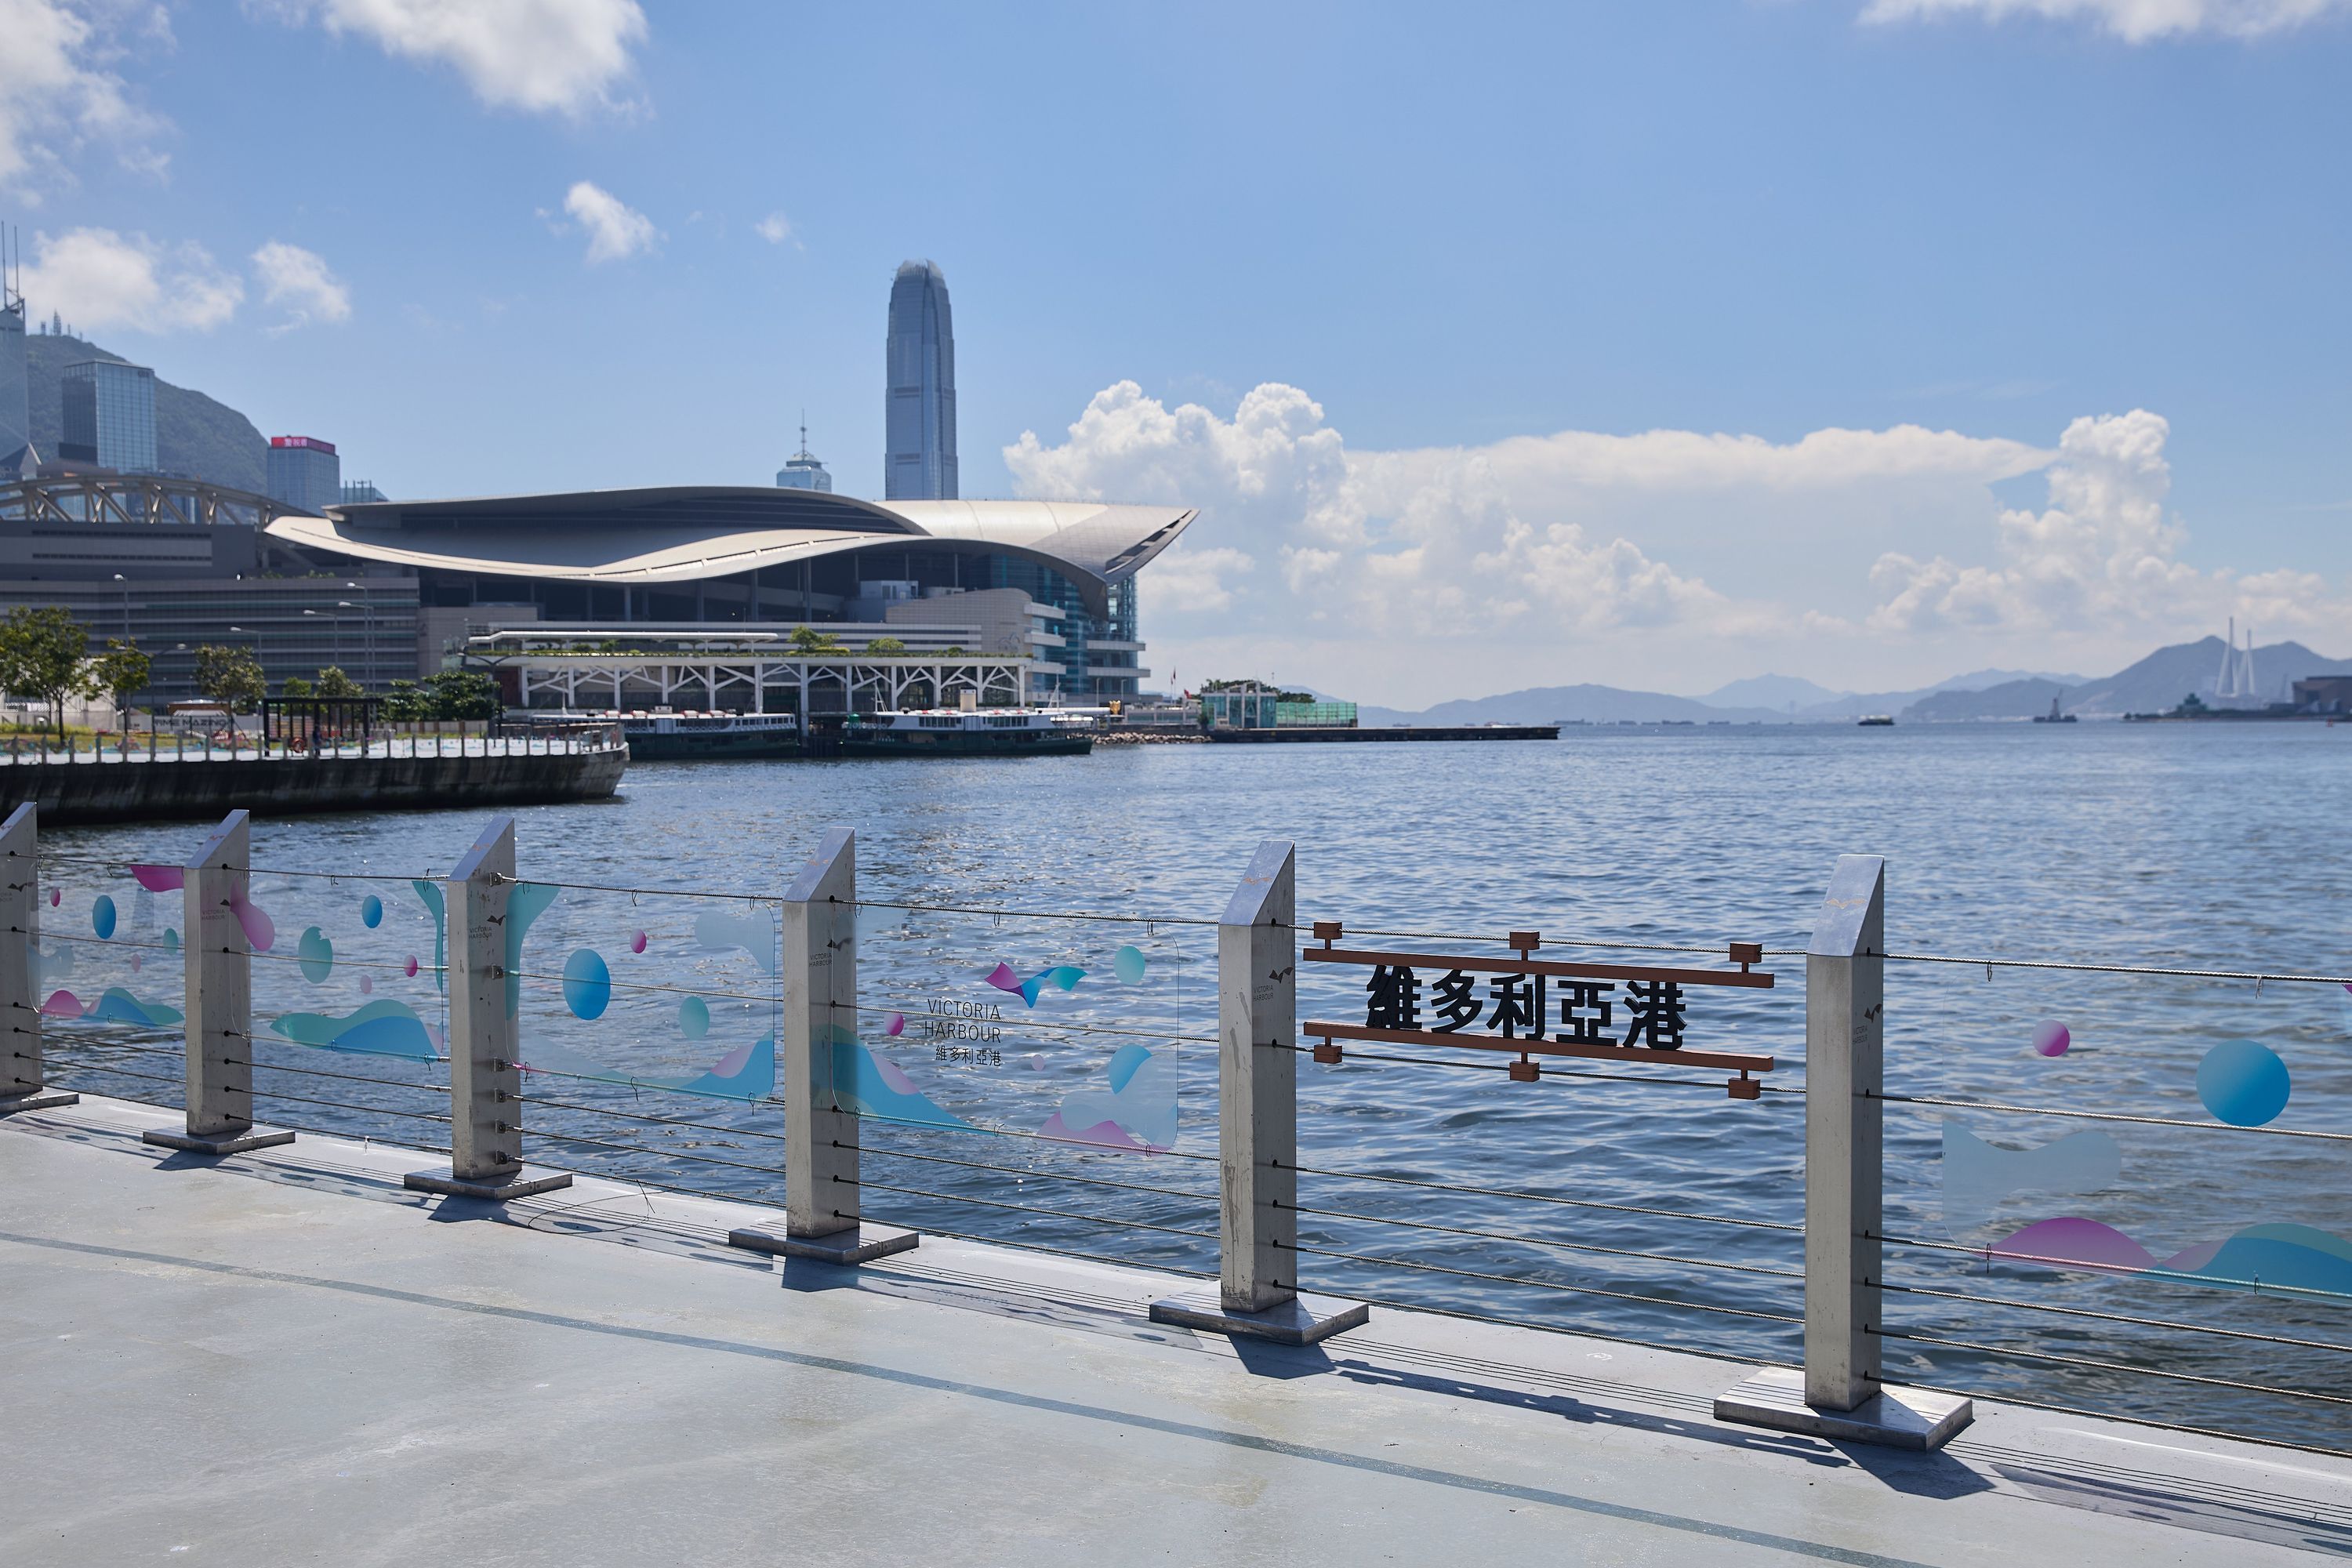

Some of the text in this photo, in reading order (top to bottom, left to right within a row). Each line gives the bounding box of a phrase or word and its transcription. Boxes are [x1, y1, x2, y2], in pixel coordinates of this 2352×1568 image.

[1254, 985, 1274, 993] VICTORIA
[1254, 992, 1274, 1001] HARBOUR
[927, 998, 1001, 1020] VICTORIA
[1366, 965, 1686, 1051] 維多利亞港
[924, 1021, 1001, 1044] HARBOUR
[935, 1045, 1001, 1067] 維多利亞港
